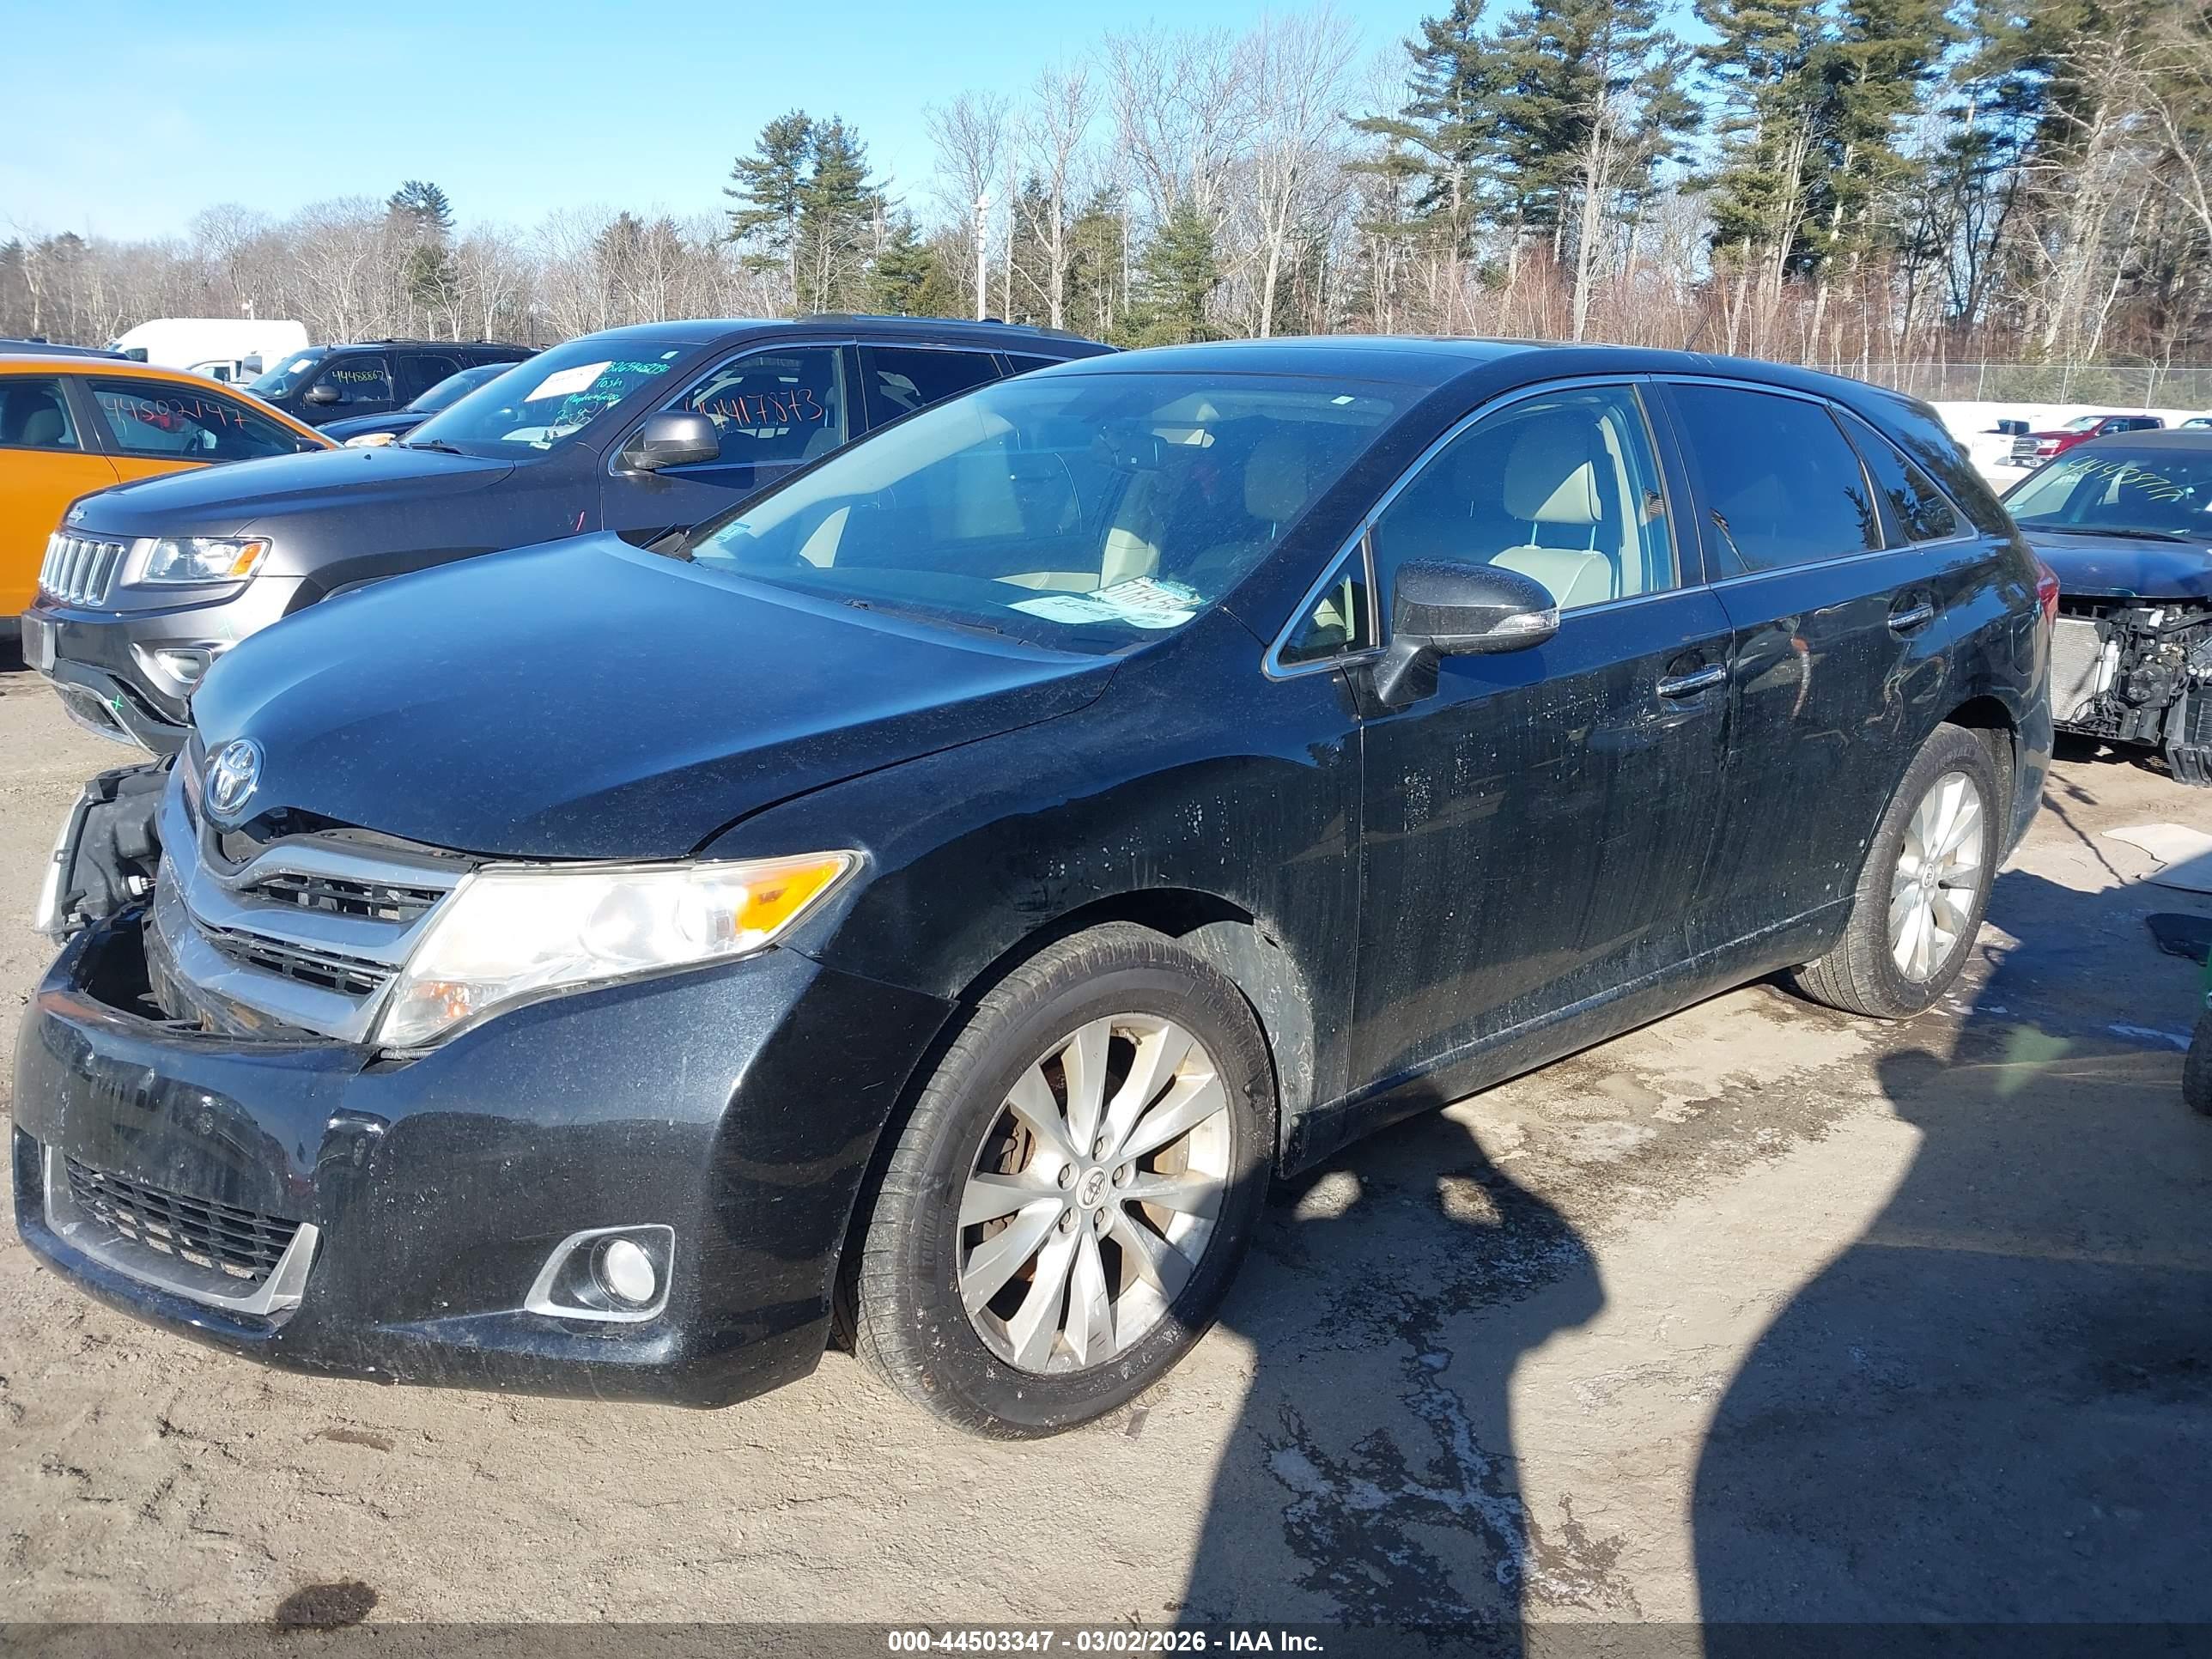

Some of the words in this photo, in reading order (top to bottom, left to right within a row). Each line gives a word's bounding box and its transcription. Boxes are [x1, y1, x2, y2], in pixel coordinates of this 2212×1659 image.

[332, 369, 384, 385] 44488867
[596, 377, 623, 388] Tosh
[104, 398, 249, 429] 44502147
